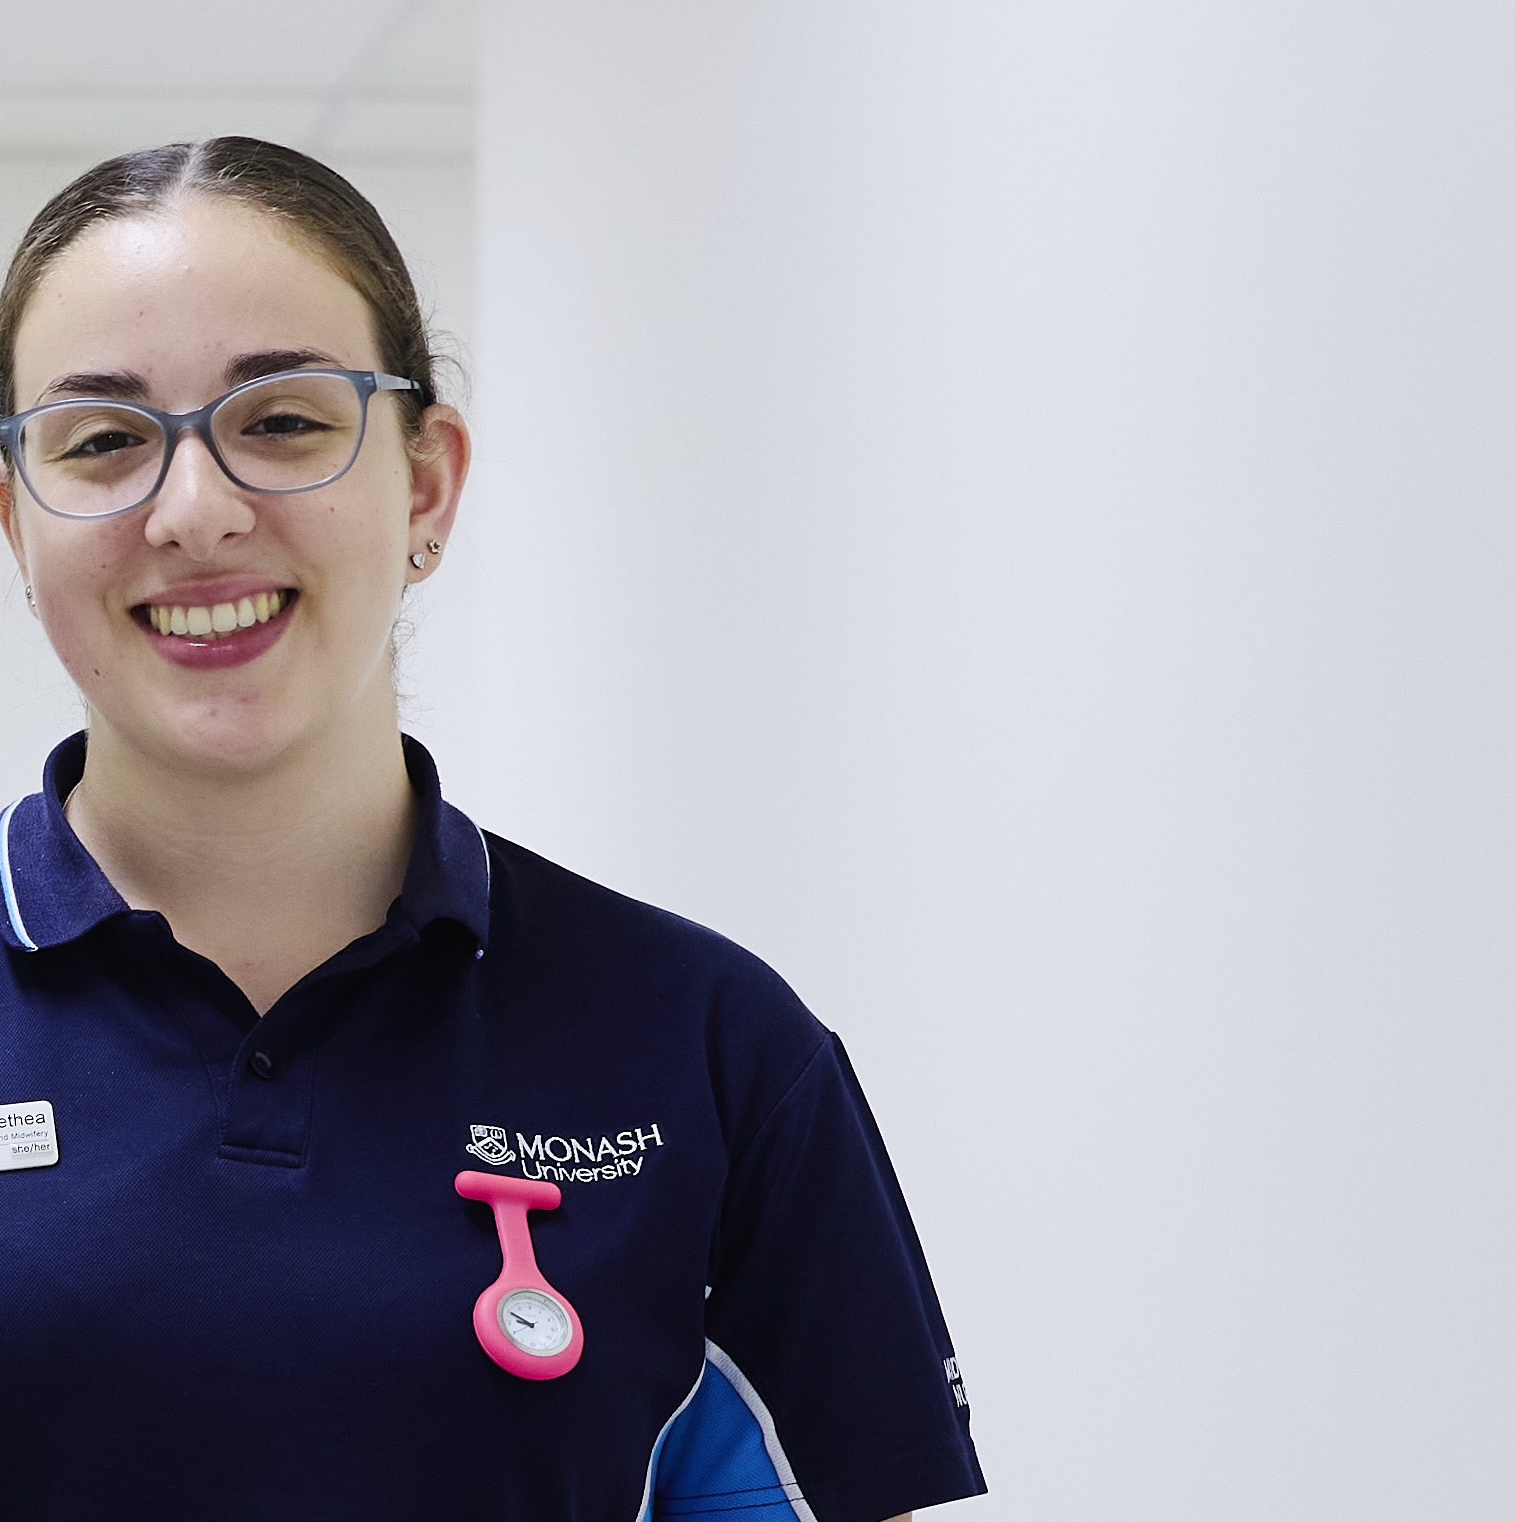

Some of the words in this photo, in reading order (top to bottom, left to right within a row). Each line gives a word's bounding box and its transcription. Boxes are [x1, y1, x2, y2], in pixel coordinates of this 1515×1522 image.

[10, 1130, 49, 1140] Midwifery
[515, 1123, 665, 1163] MONASH
[11, 1143, 51, 1154] she/her
[521, 1156, 644, 1182] University
